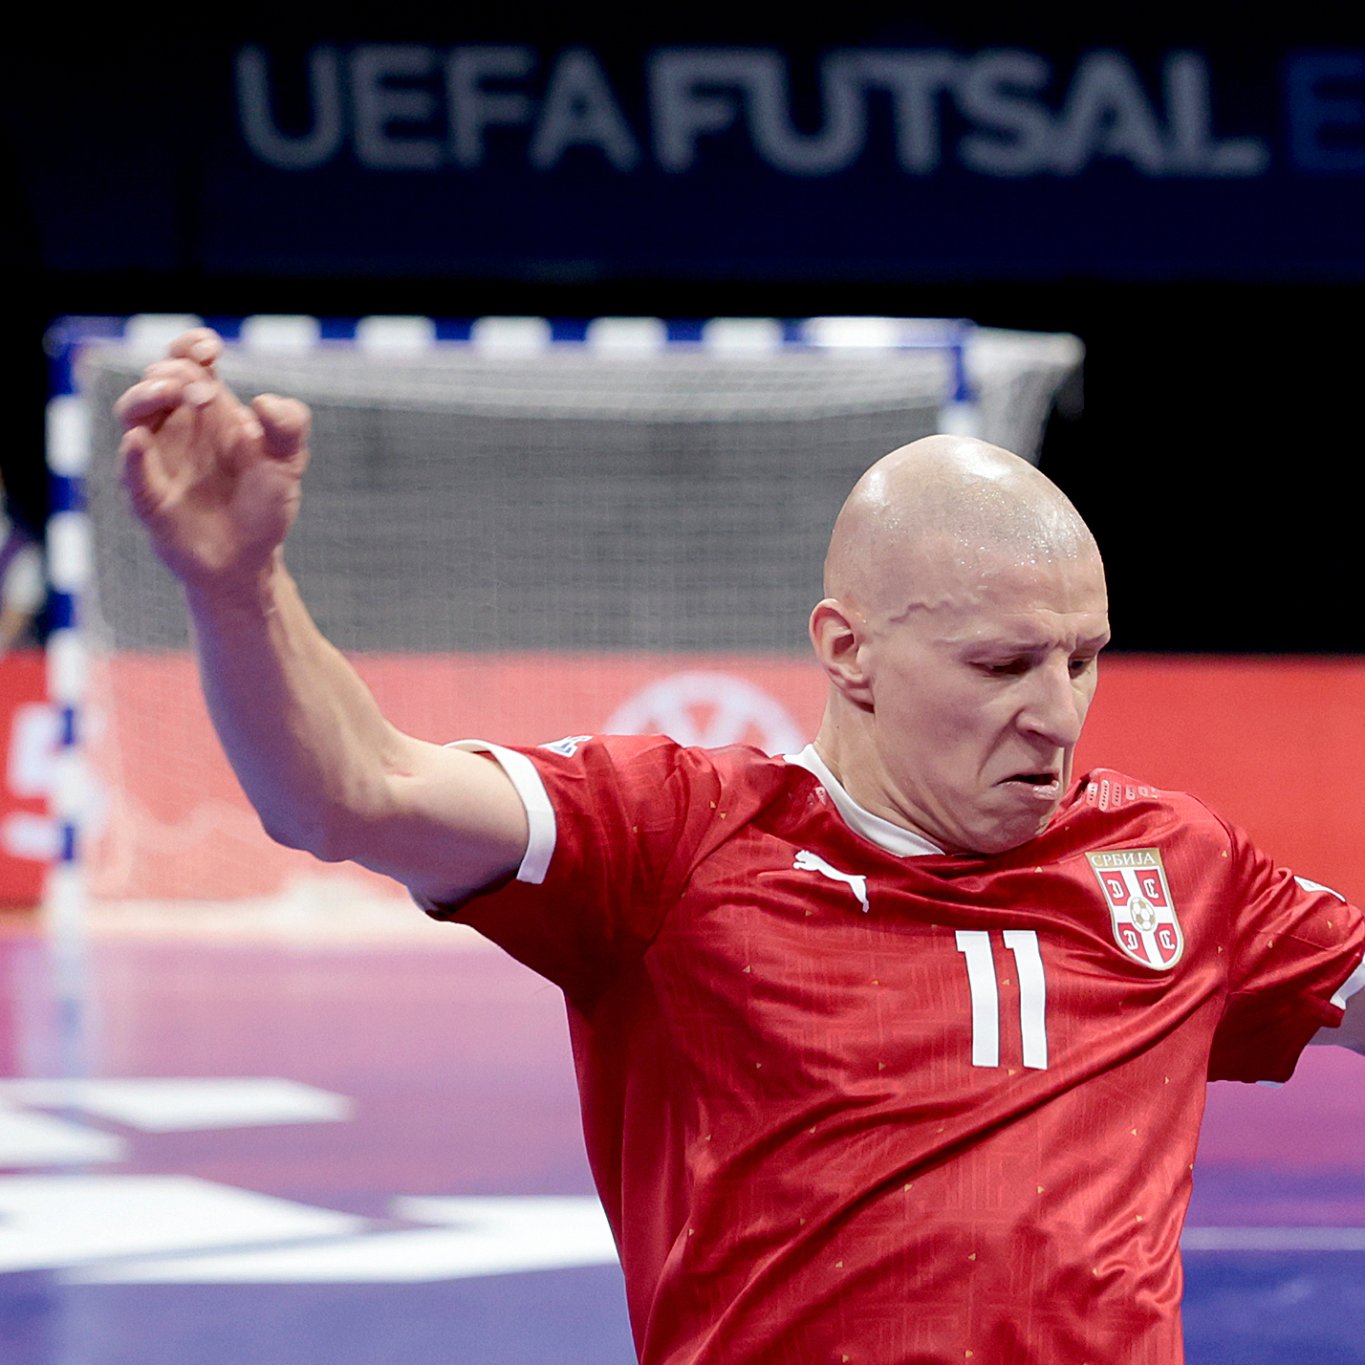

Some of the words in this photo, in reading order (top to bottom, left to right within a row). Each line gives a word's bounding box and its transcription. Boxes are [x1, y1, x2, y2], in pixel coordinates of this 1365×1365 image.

[237, 46, 638, 170] UEFA
[647, 47, 1268, 176] FUTSAL
[1091, 851, 1156, 867] СРБИЈА
[955, 930, 1048, 1070] 11
